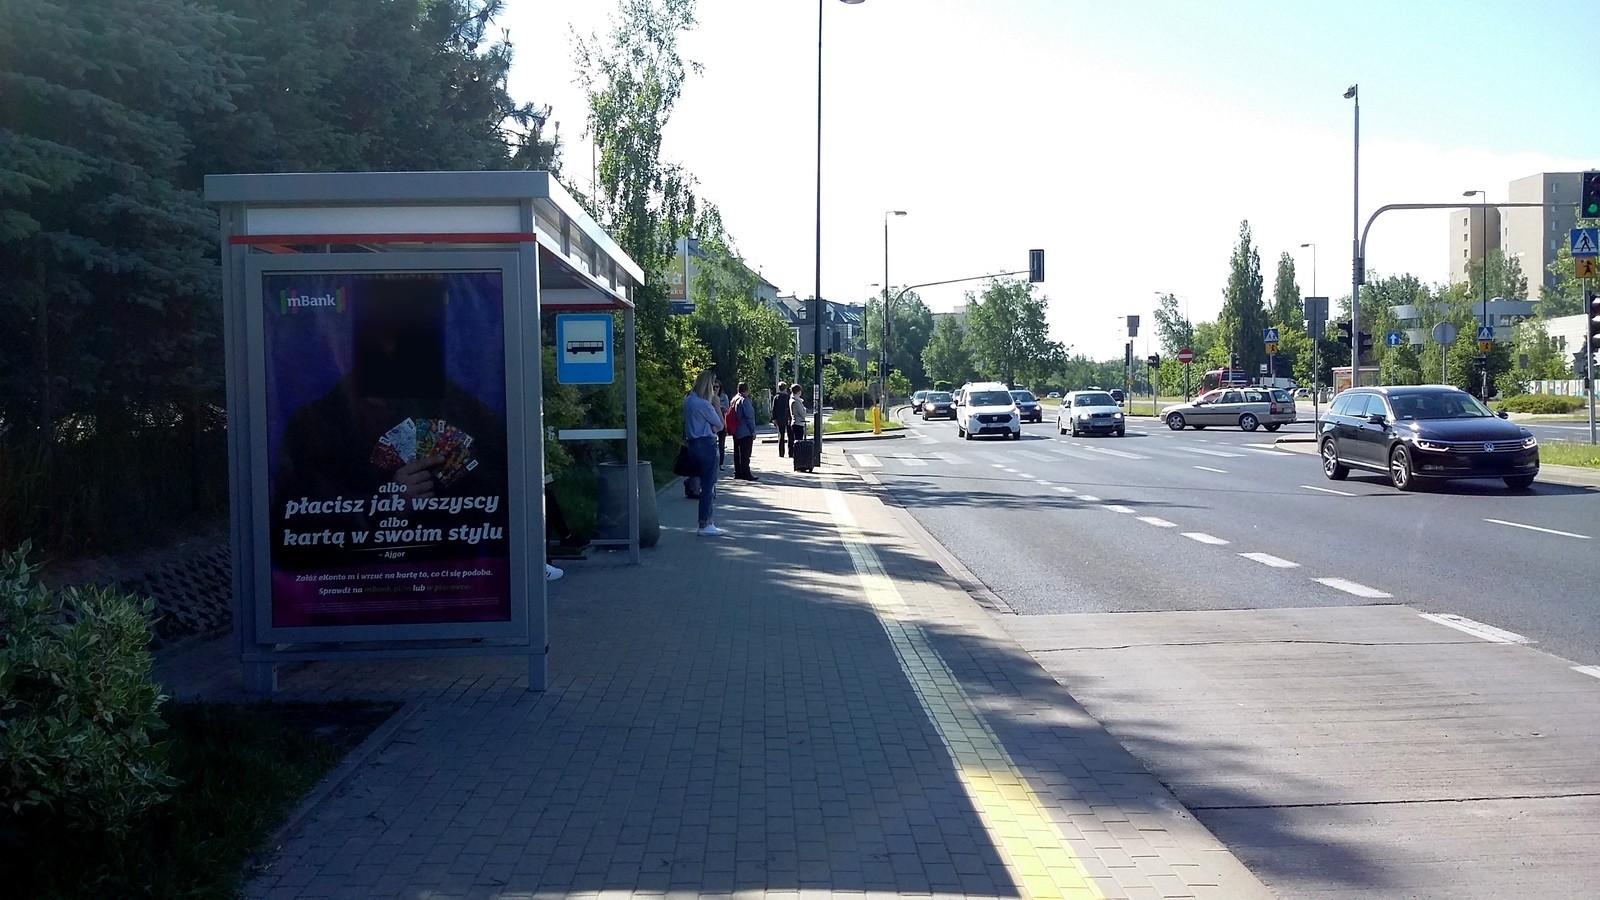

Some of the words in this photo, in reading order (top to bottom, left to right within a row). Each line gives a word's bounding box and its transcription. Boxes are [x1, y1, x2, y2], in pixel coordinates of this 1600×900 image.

[287, 294, 336, 307] mBank
[378, 482, 408, 493] albo
[284, 496, 364, 519] płacisz
[368, 494, 406, 516] jak
[412, 495, 499, 514] wszyscy
[379, 517, 409, 528] albo
[283, 529, 345, 548] kartą
[351, 531, 369, 544] w
[374, 524, 442, 543] swoim
[448, 522, 503, 544] stylu
[384, 550, 406, 559] Ajgor
[318, 573, 346, 581] eKonto
[396, 571, 417, 580] kartę
[450, 569, 461, 578] się
[462, 569, 493, 578] podoba.
[412, 584, 426, 592] lub
